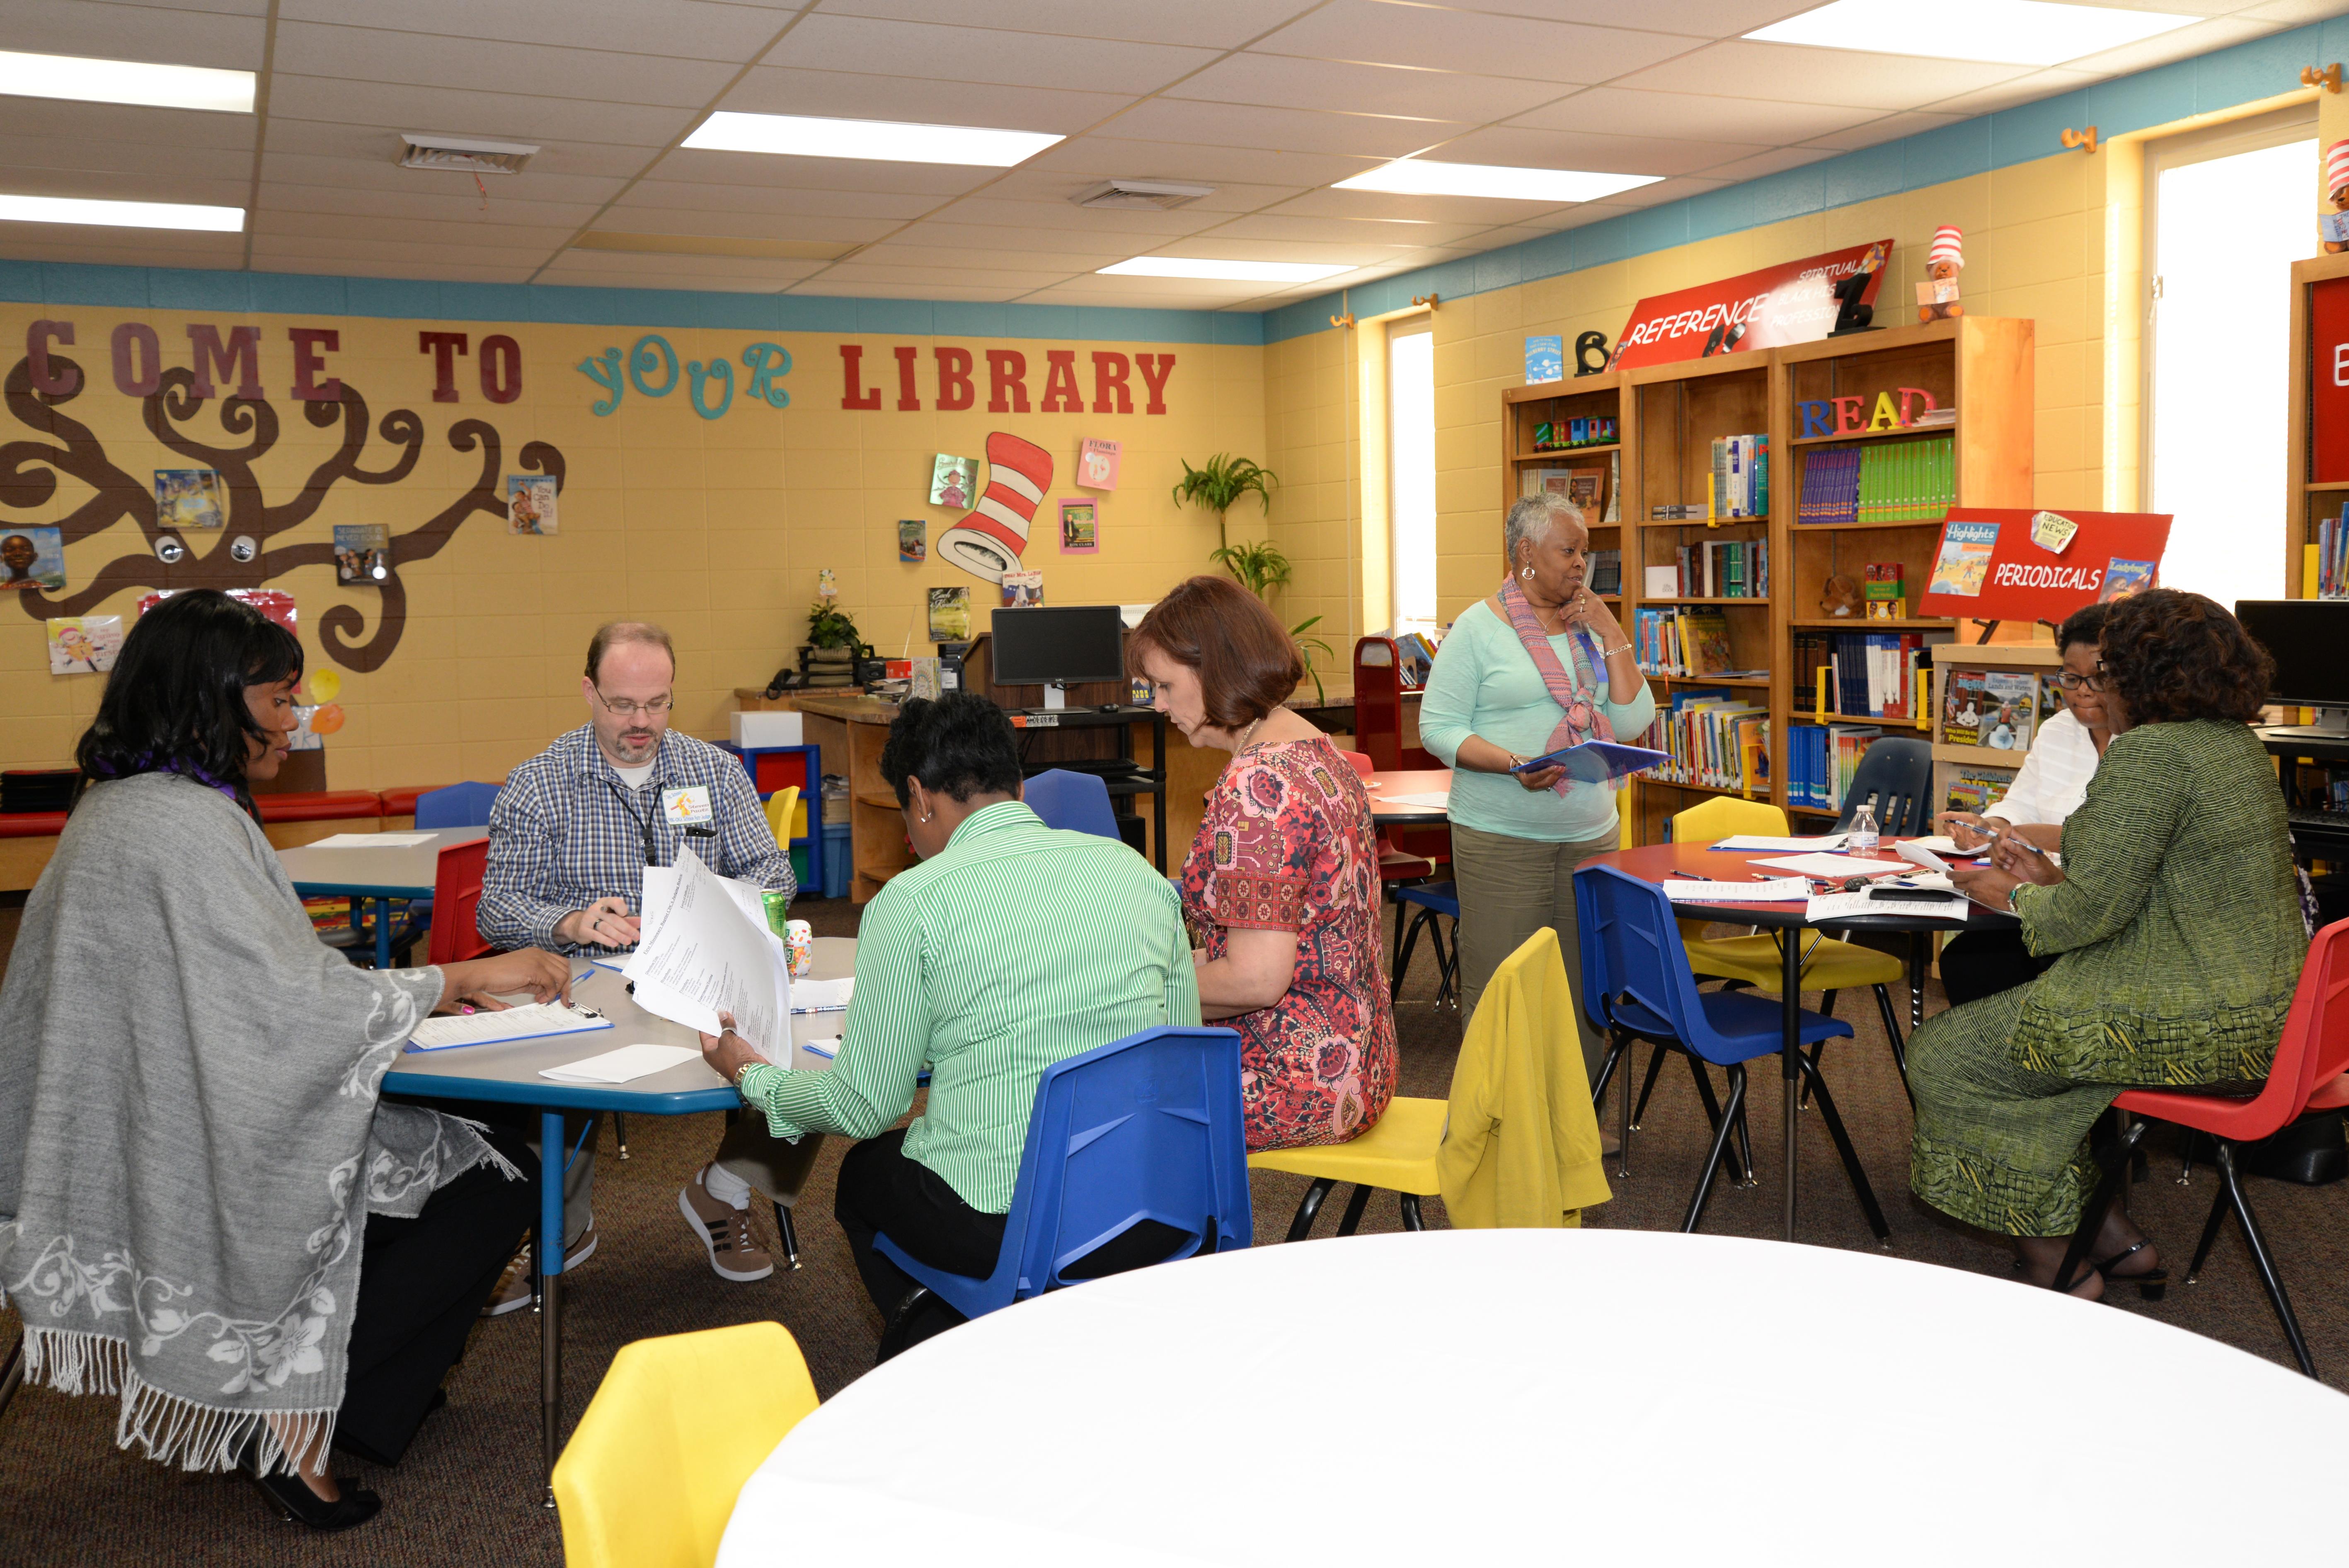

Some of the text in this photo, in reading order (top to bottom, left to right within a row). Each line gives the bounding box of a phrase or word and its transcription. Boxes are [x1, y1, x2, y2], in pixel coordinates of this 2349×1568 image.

[1797, 260, 1857, 284] SPIRITUAL
[1778, 284, 1837, 306] BLACK HIS
[1627, 293, 1769, 347] REFERENCE
[1770, 305, 1840, 327] PROFESSION
[26, 319, 341, 401] COME
[419, 331, 522, 404] TO
[840, 345, 1176, 415] LIBRARY
[1798, 387, 1937, 438] READ
[1089, 440, 1116, 451] FLORA
[536, 485, 552, 494] You
[538, 501, 549, 509] Do
[1946, 524, 1995, 541] Highlights
[1994, 563, 2102, 590] PERIODICALS
[2109, 561, 2148, 574] Ladybug
[1948, 734, 1978, 744] Presiden
[1960, 769, 1976, 779] The
